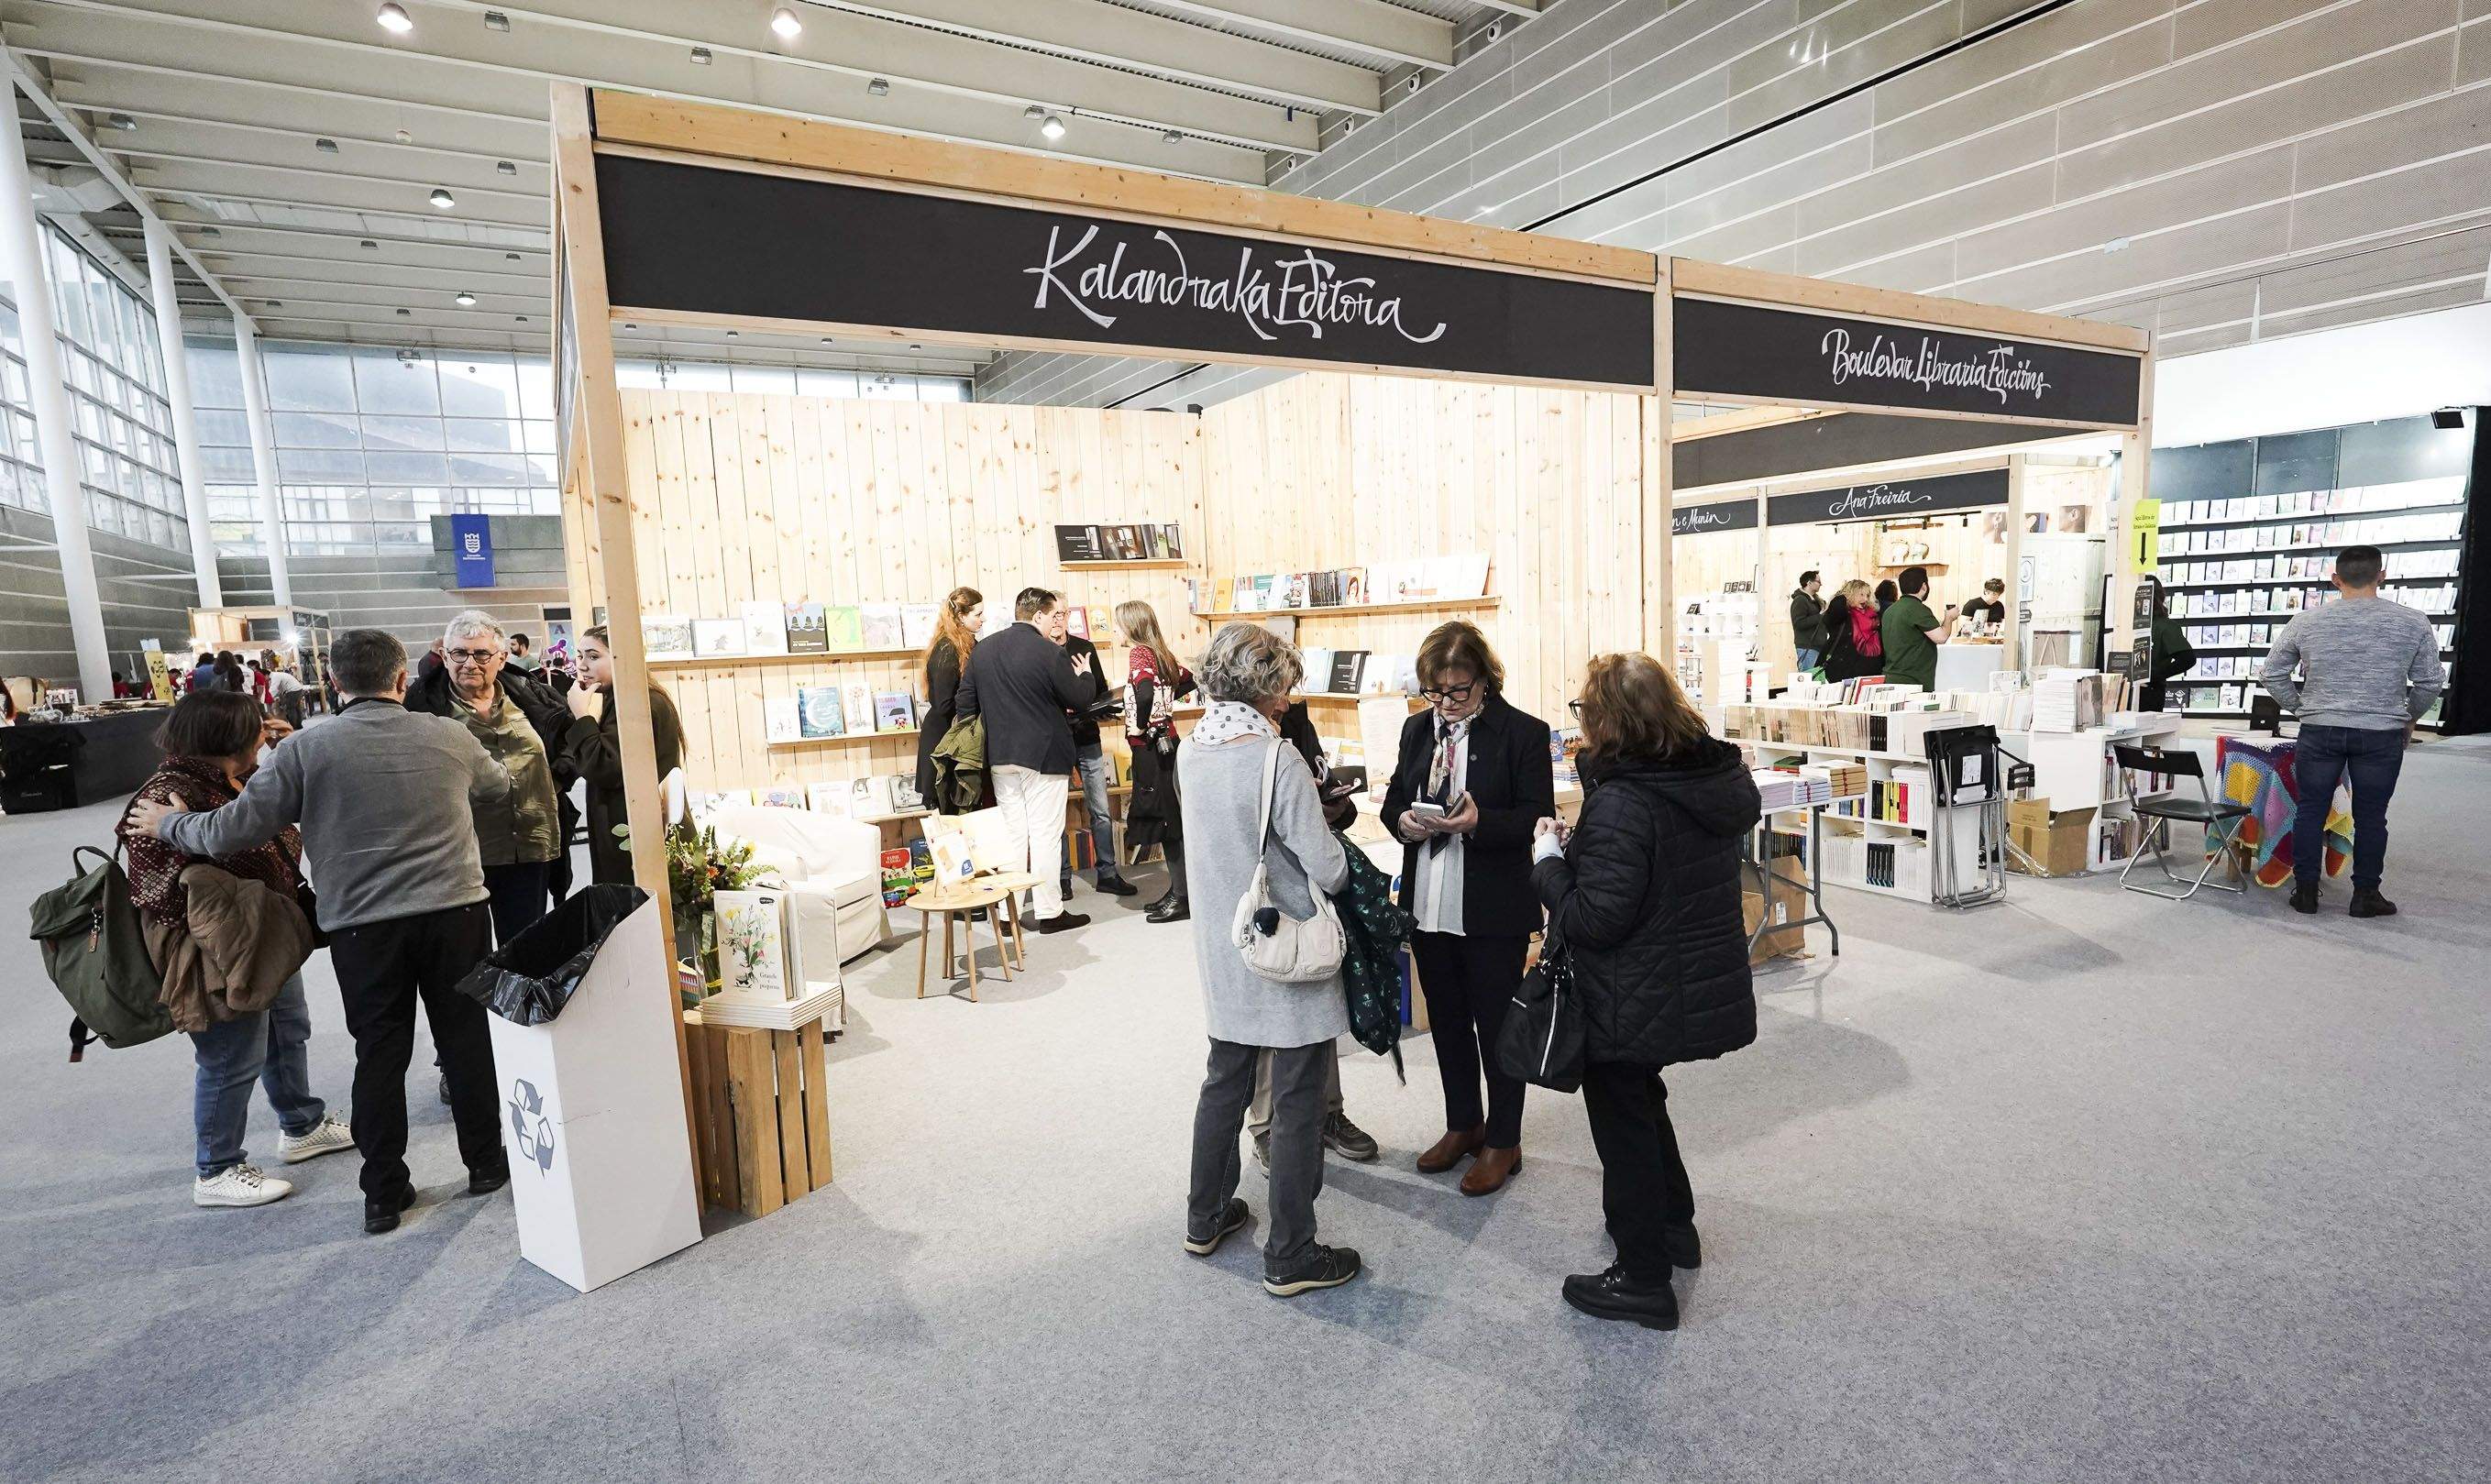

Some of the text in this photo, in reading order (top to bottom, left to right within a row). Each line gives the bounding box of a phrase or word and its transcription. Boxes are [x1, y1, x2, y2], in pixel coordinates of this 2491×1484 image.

[1023, 225, 1447, 343] Kalandraka Editora
[1822, 328, 1914, 385] Boulevar
[1829, 487, 1867, 518] Ana
